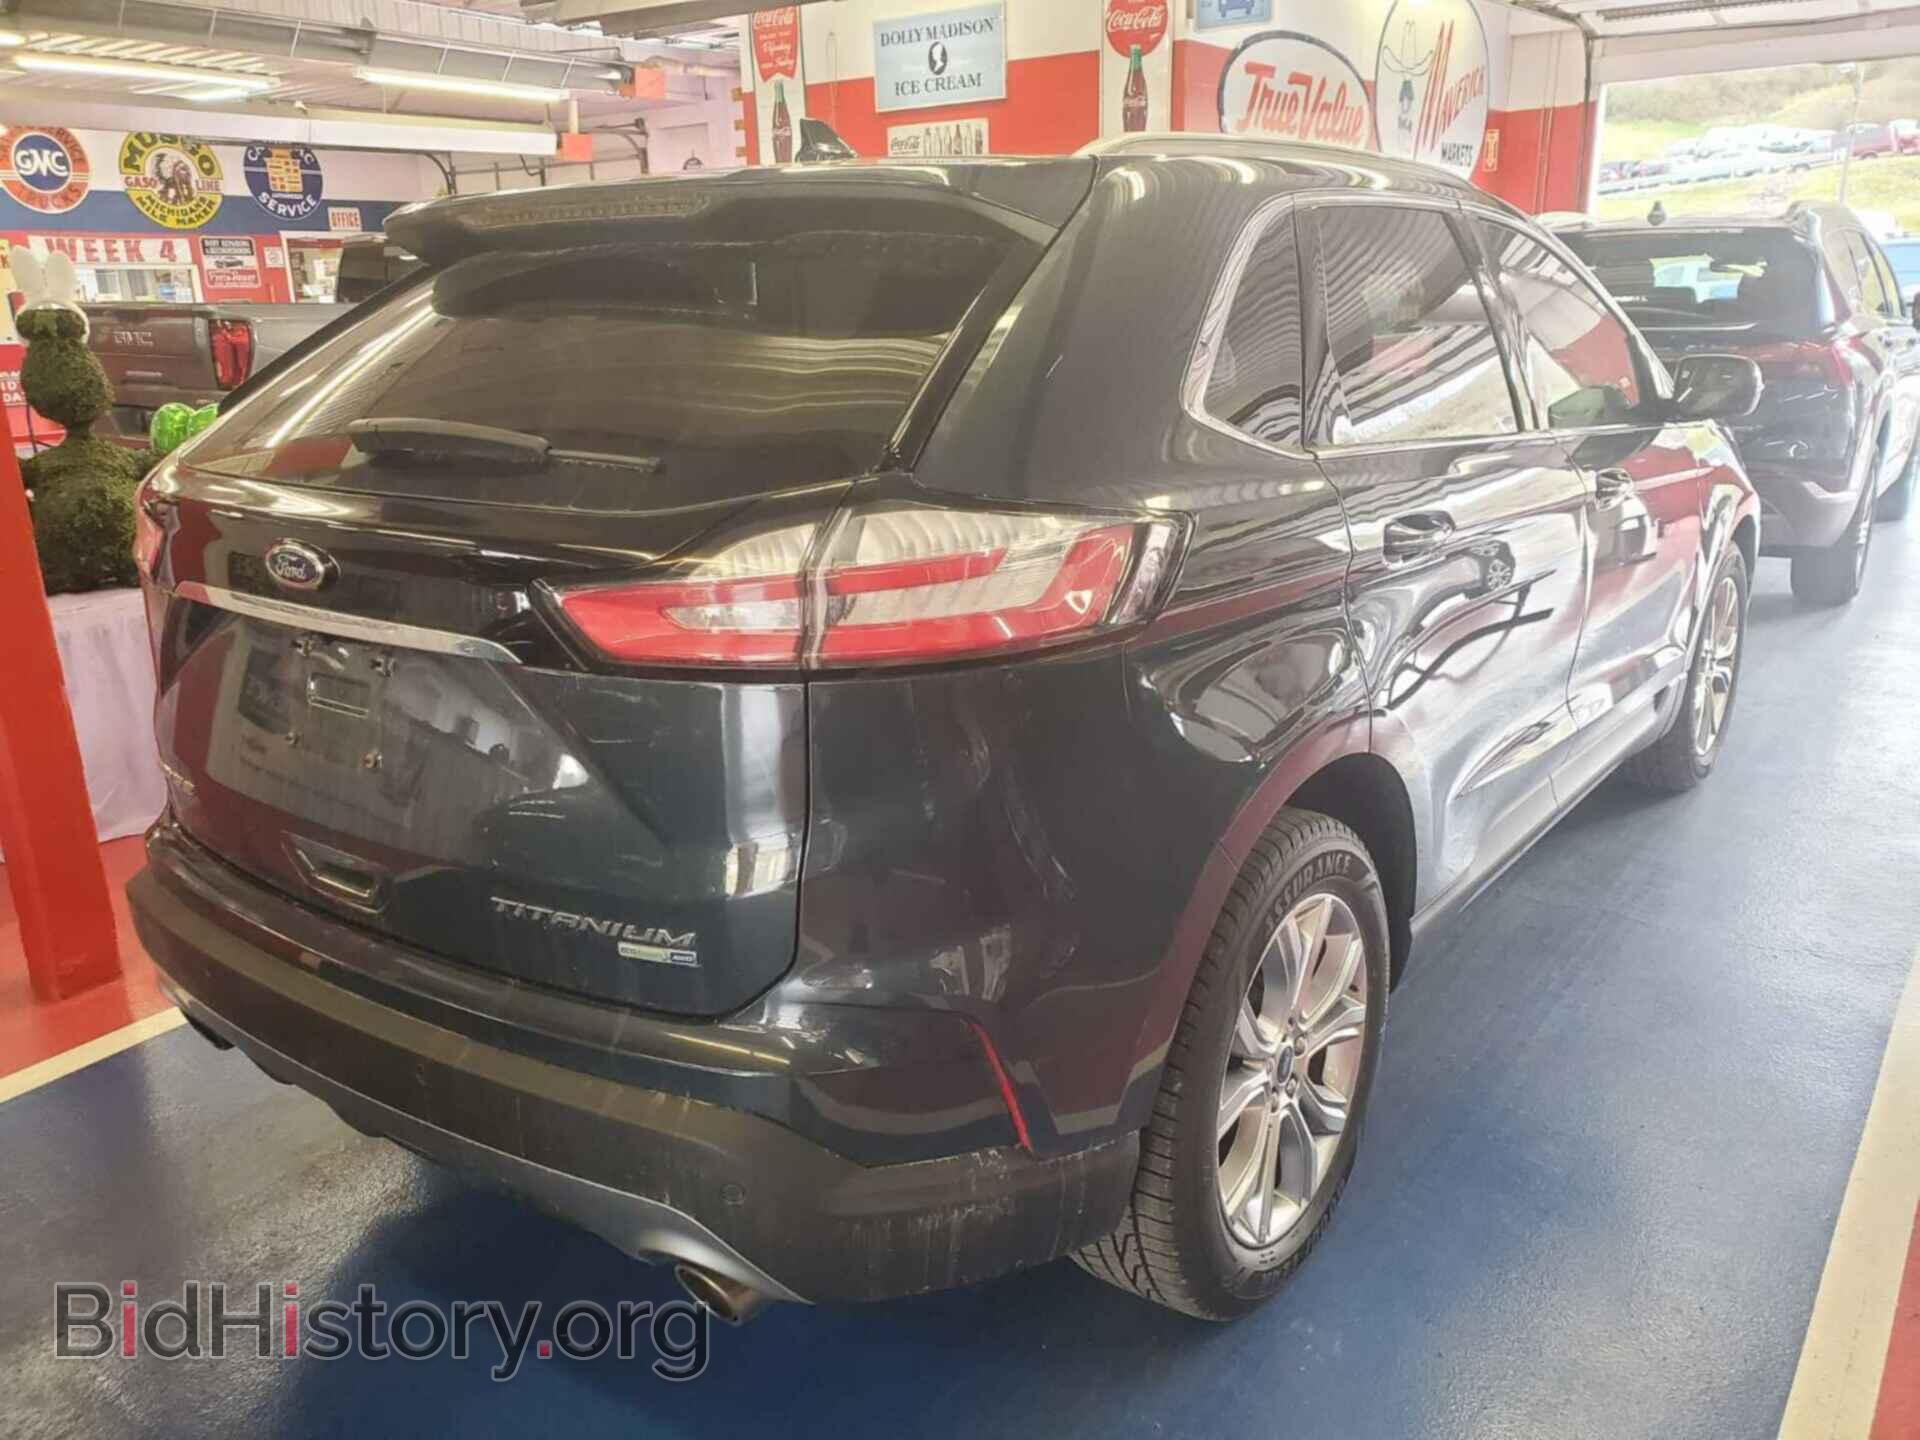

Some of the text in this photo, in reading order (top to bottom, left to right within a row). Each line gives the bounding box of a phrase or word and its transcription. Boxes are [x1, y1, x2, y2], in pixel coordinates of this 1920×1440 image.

[879, 17, 998, 47] DOLLY MADISON
[894, 72, 982, 96] ICE CREAM
[1234, 61, 1364, 145] True Value
[15, 147, 69, 177] GMC
[1440, 141, 1474, 168] MARKETS
[124, 176, 221, 191] GASO LINE
[135, 196, 216, 225] MILE MAKER
[257, 191, 317, 218] SERVICE
[331, 211, 361, 227] OFFICE
[44, 238, 177, 263] WEEK 4
[274, 554, 306, 580] Ford
[1263, 853, 1352, 934] ASSURANCE
[490, 896, 697, 947] TITANIUM
